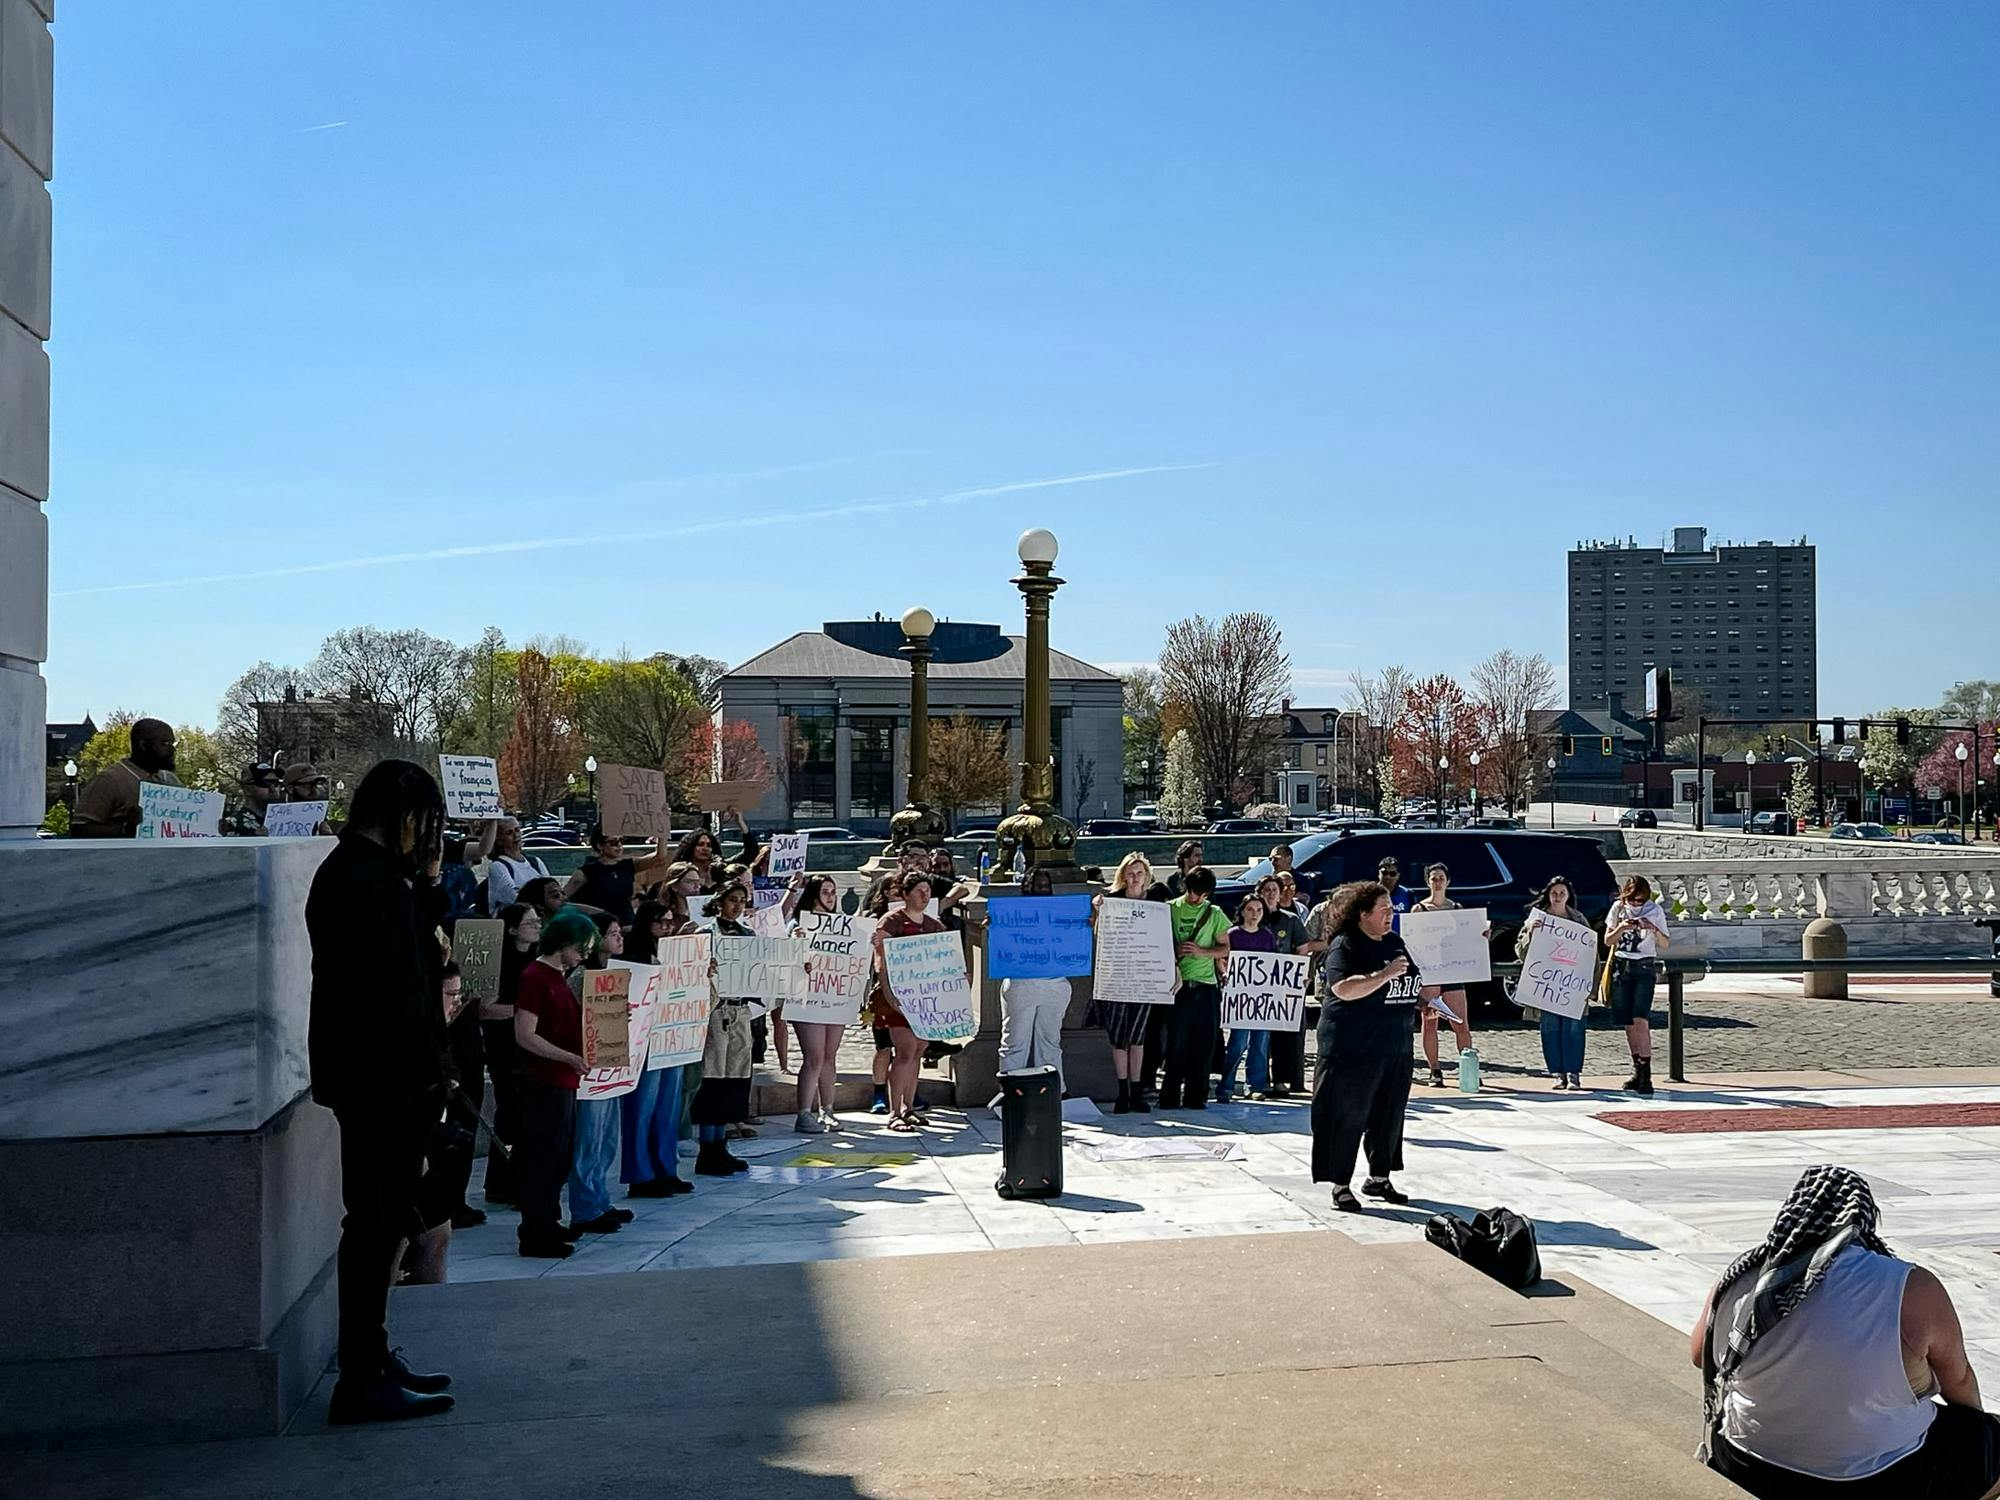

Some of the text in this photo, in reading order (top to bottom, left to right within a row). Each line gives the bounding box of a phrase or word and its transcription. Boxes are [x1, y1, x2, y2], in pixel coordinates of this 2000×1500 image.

[619, 769, 660, 793] SAVE
[623, 793, 655, 815] THE
[774, 838, 800, 852] SAVE
[756, 890, 780, 902] This
[807, 912, 854, 937] JACK
[1540, 916, 1578, 942] How
[464, 947, 489, 966] ART
[1227, 955, 1306, 990] ARTS ARE
[1528, 960, 1593, 993] Condone
[1532, 980, 1571, 1006] This
[1222, 991, 1303, 1024] IMPORTANT
